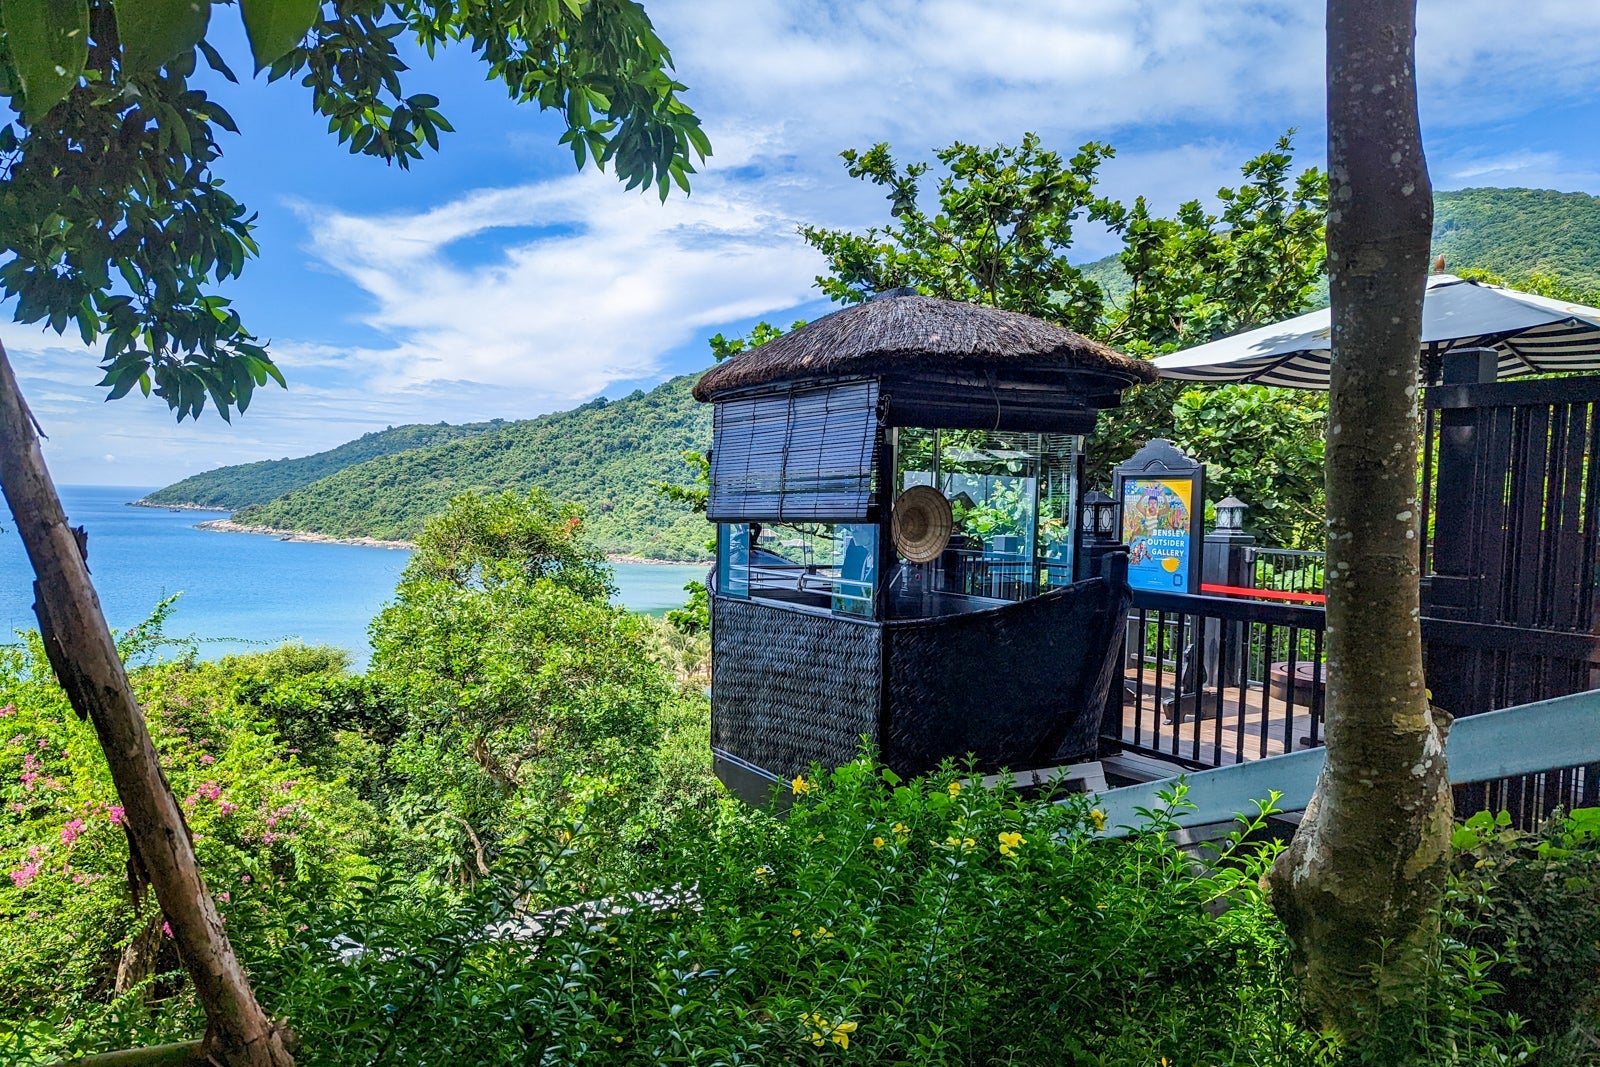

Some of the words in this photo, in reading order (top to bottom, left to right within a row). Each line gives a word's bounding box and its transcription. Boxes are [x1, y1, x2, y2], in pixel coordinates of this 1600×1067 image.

[1152, 529, 1185, 537] BENSLEY
[1147, 539, 1185, 547] OUTSIDER
[1151, 548, 1184, 557] GALLERY
